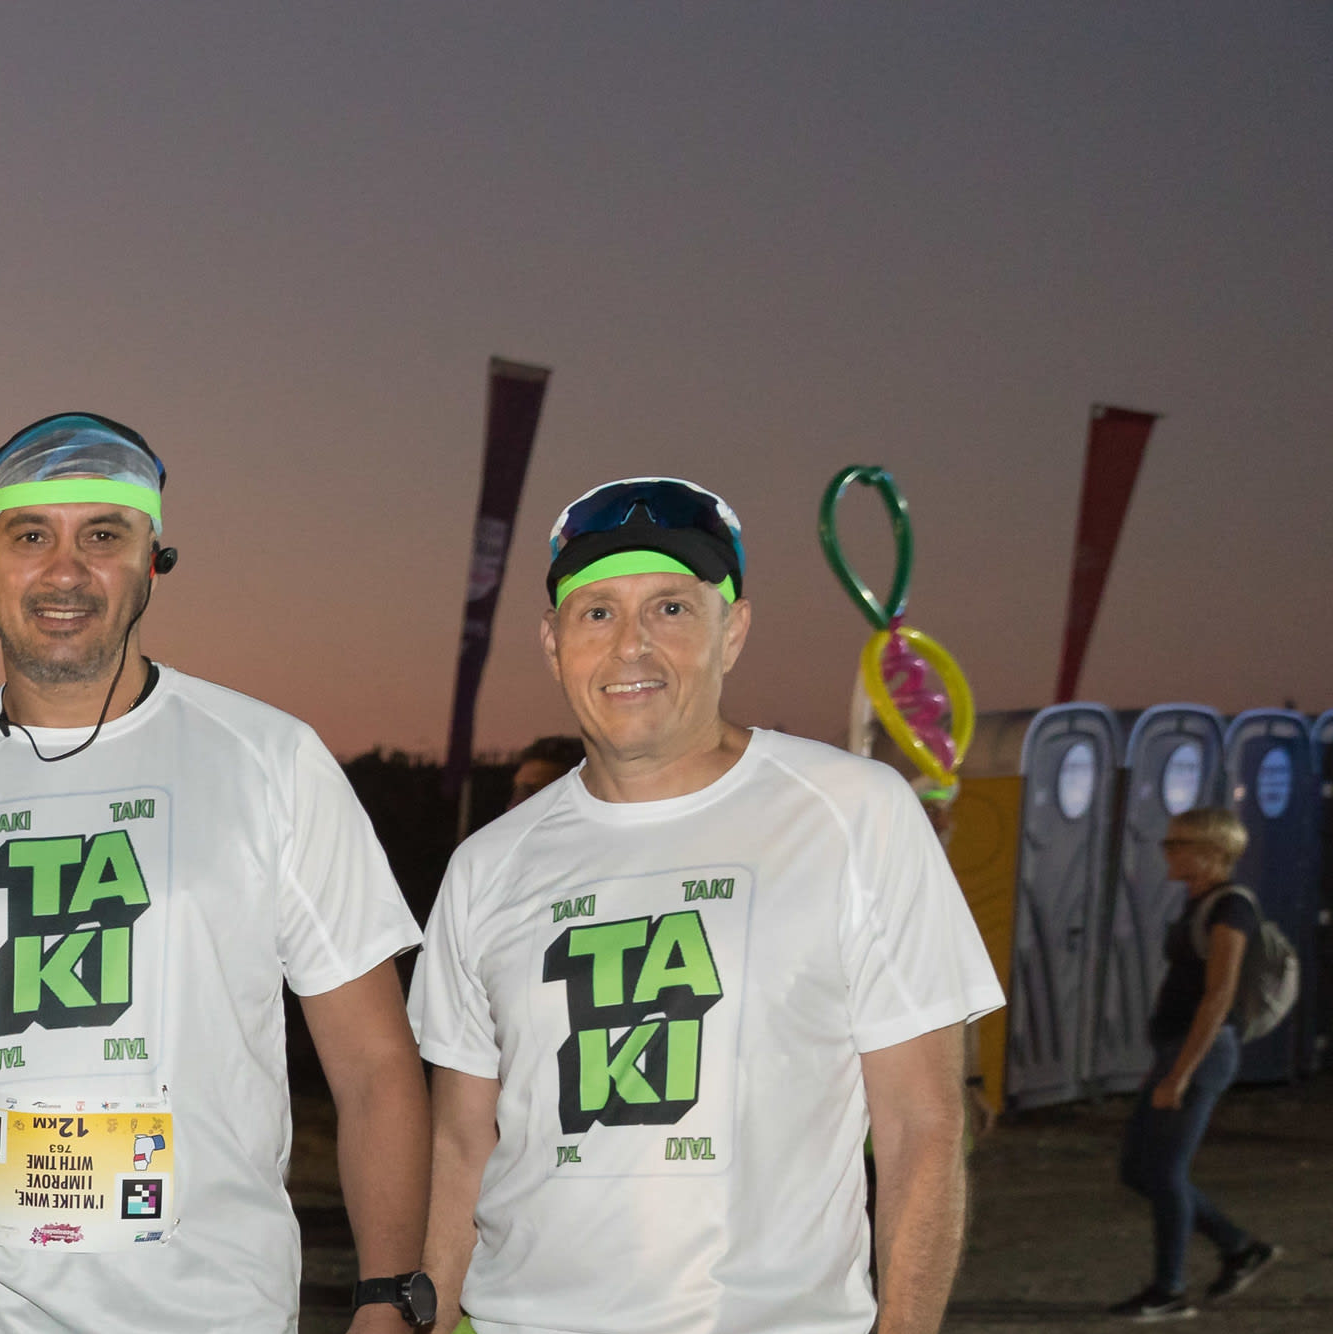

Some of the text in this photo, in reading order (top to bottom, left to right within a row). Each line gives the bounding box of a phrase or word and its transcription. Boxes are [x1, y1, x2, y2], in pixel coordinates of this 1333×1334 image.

[110, 799, 154, 822] TAKI
[682, 878, 735, 901] TAKI
[551, 895, 596, 922] TAKI
[542, 910, 724, 1010] TA
[104, 1038, 148, 1060] TAKI
[557, 1019, 703, 1114] KI
[49, 1144, 72, 1153] 763
[665, 1137, 715, 1160] TAKI
[26, 1154, 93, 1171] WITH TIME
[26, 1173, 93, 1190] I IMPROVE
[14, 1189, 104, 1209] I'M LIKE WINE,
